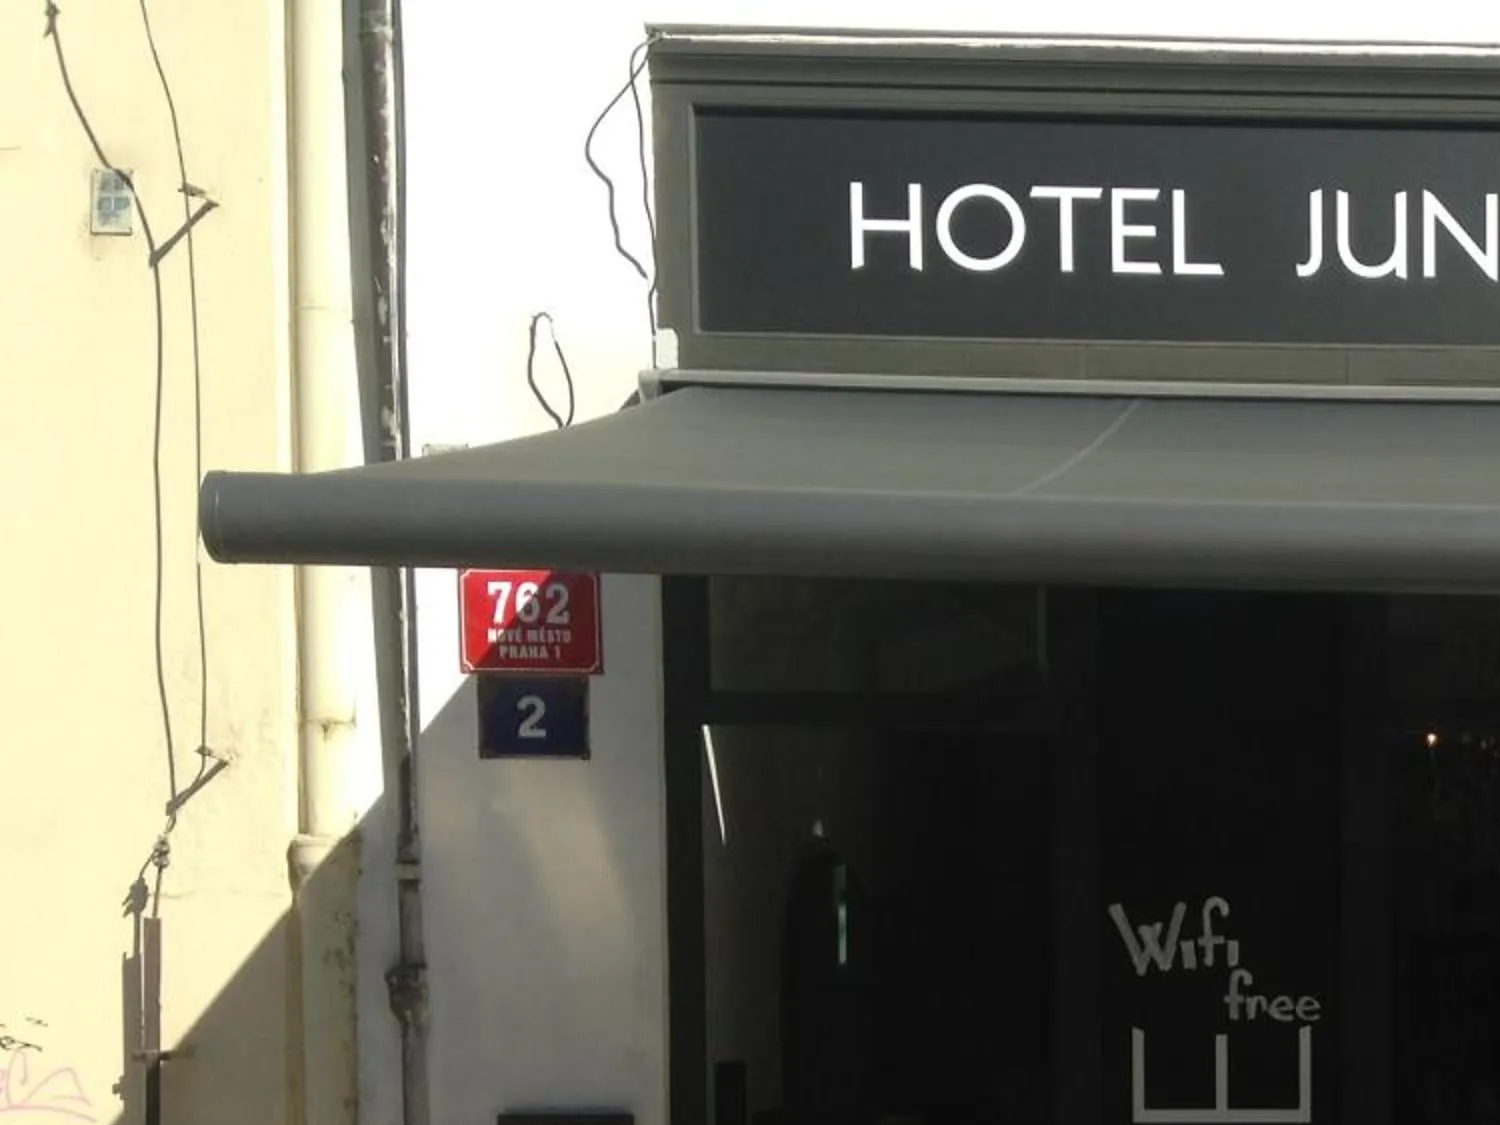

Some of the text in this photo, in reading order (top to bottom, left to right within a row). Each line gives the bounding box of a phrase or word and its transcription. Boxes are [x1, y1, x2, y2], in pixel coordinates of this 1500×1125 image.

[848, 180, 1226, 279] HOTEL
[487, 581, 569, 625] 762
[487, 627, 522, 643] NOVÉ
[499, 645, 562, 660] PRAHA 1
[516, 695, 547, 738] 2
[1109, 896, 1240, 976] Wifi
[1224, 967, 1321, 1022] free
